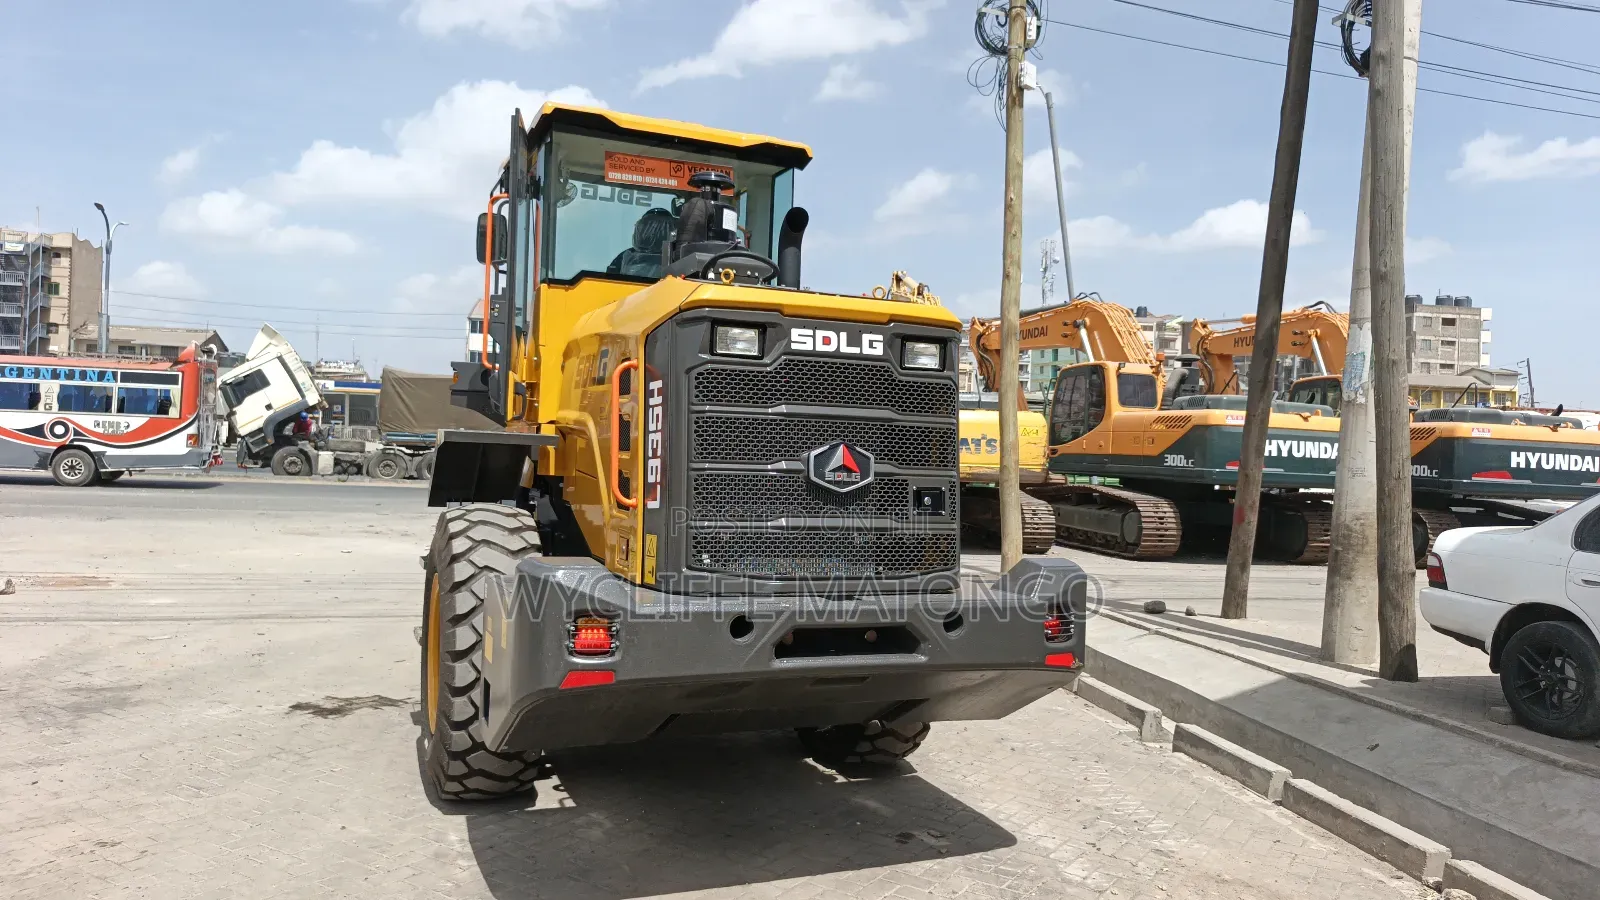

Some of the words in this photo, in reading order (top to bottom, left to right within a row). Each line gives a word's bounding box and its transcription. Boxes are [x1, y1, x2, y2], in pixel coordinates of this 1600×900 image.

[608, 156, 628, 164] SOLD
[630, 158, 645, 166] AND
[609, 163, 645, 173] SERVICED
[1019, 325, 1048, 341] YUNDAI
[790, 328, 884, 356] SDLG
[0, 365, 116, 383] GENTINA
[1264, 439, 1339, 460] HYUNDA
[1510, 451, 1600, 473] HYUNDAI
[825, 472, 861, 482] SDLG
[1411, 464, 1439, 478] 00LC
